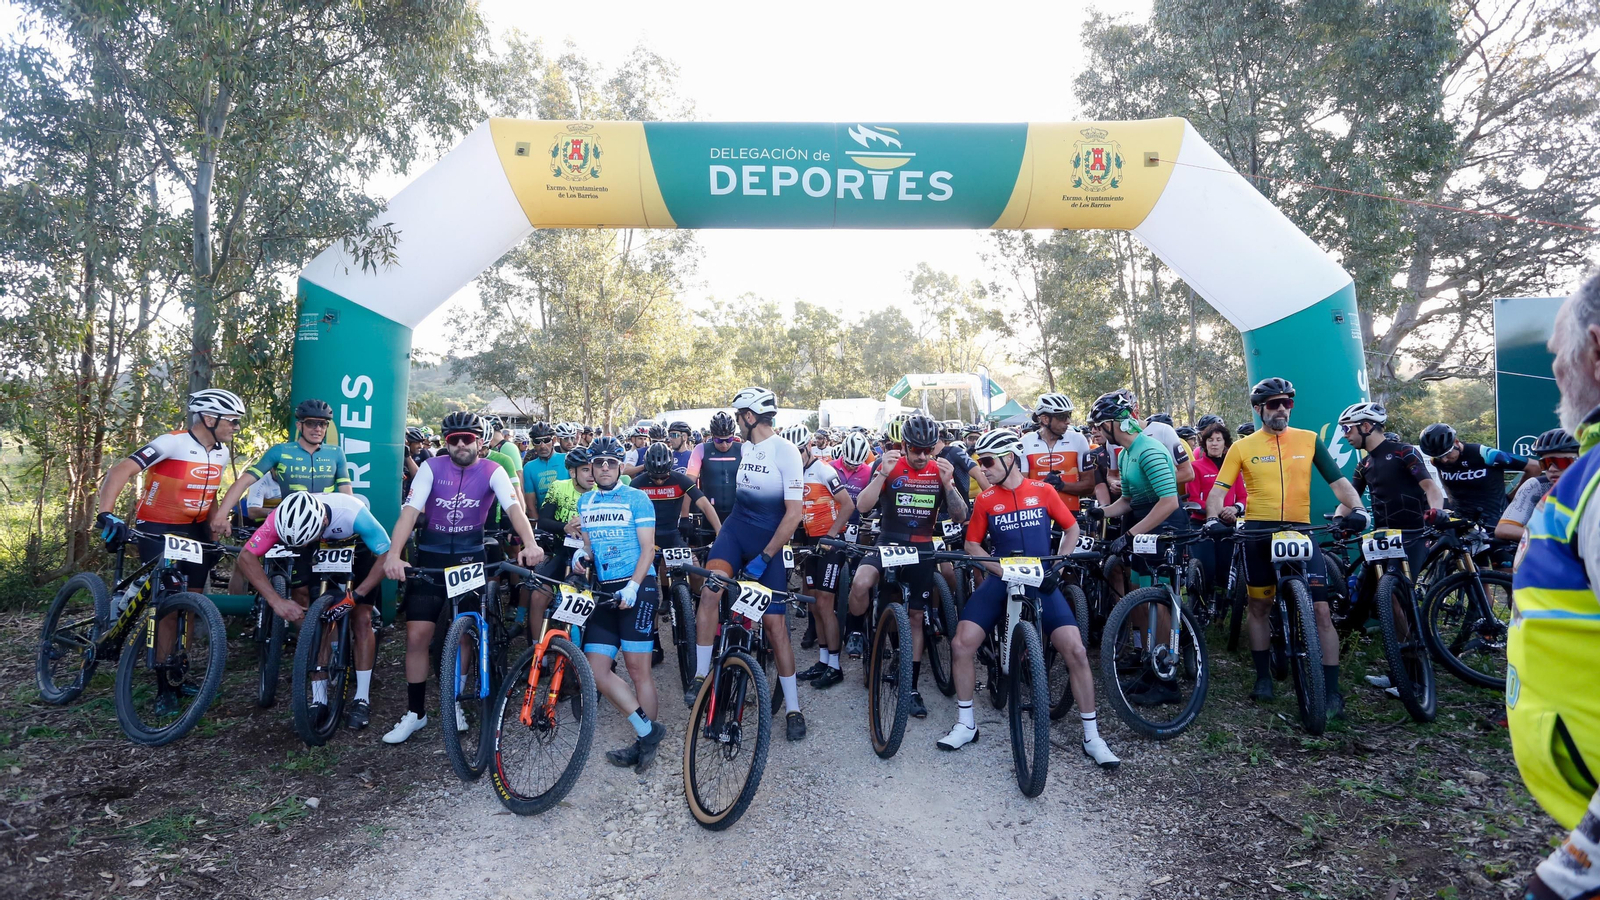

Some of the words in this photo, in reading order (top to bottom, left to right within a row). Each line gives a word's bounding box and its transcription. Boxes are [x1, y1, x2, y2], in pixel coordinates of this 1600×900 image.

[710, 147, 808, 161] DELEGACIÓN
[813, 150, 831, 161] de
[709, 165, 954, 201] DEPORTES
[588, 513, 625, 523] MANILVA
[994, 512, 1018, 526] FALI
[1020, 508, 1043, 521] BIKE
[168, 536, 200, 554] 021
[1274, 541, 1309, 558] 001
[317, 549, 353, 563] 309
[665, 549, 691, 561] 355
[448, 563, 484, 588] 062
[823, 563, 833, 588] SYMSUR
[563, 593, 596, 617] 166
[740, 586, 771, 612] 279
[493, 772, 511, 801] MAXXIS
